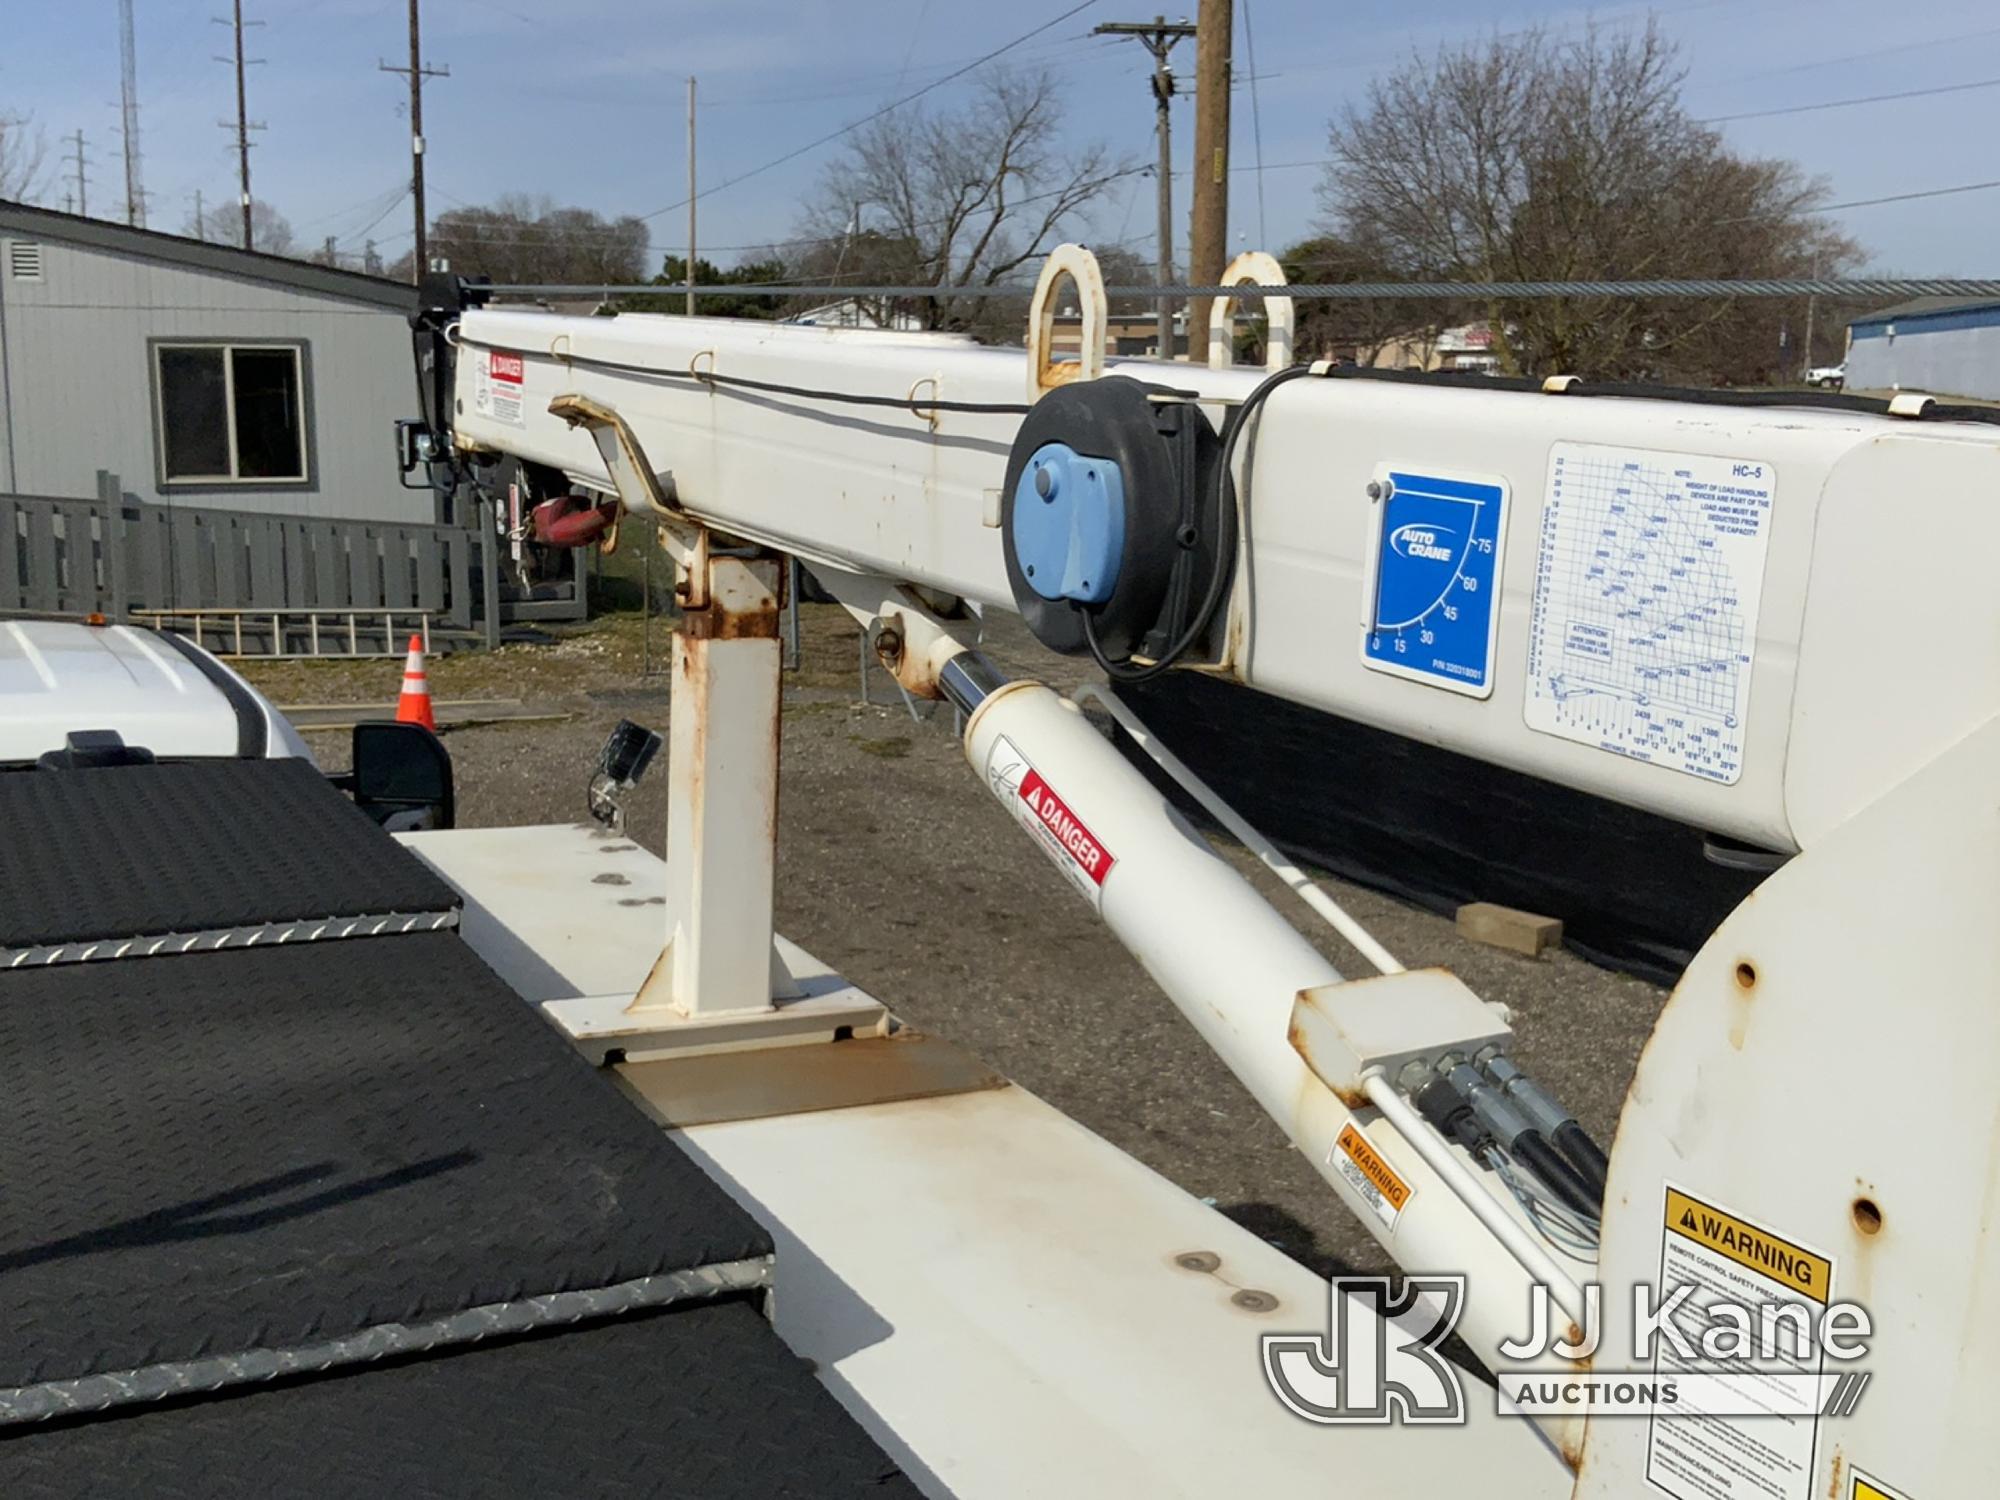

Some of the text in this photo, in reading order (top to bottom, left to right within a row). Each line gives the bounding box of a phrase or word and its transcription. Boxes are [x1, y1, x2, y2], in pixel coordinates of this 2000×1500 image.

[1732, 465, 1762, 478] HC-5
[1686, 482, 1708, 490] WEIGHT
[1719, 485, 1735, 494] LOAD
[1736, 488, 1768, 498] HANDLING
[1690, 492, 1716, 500] DEVICES
[1542, 506, 1550, 535] CRANE
[1708, 514, 1759, 526] DEDUCTED FROM
[1400, 530, 1435, 544] AUTO
[1714, 524, 1757, 536] THE CAPACITY
[1478, 539, 1492, 554] 75
[1541, 538, 1546, 549] OF
[1408, 543, 1452, 561] CRANE
[1463, 577, 1477, 592] 60
[1443, 606, 1458, 620] 45
[1533, 624, 1538, 633] IN
[1372, 638, 1380, 650] 0
[1420, 631, 1434, 644] 30
[1394, 639, 1406, 653] 15
[1529, 634, 1537, 676] DISTANCE
[1433, 659, 1445, 670] P/N
[1040, 797, 1100, 873] DANGER
[1354, 1142, 1402, 1202] WARNING
[1701, 1213, 1812, 1286] WARNING
[1669, 1244, 1696, 1262] REMOTE
[1696, 1256, 1727, 1278] CONTROL
[1728, 1272, 1754, 1290] SAFETY
